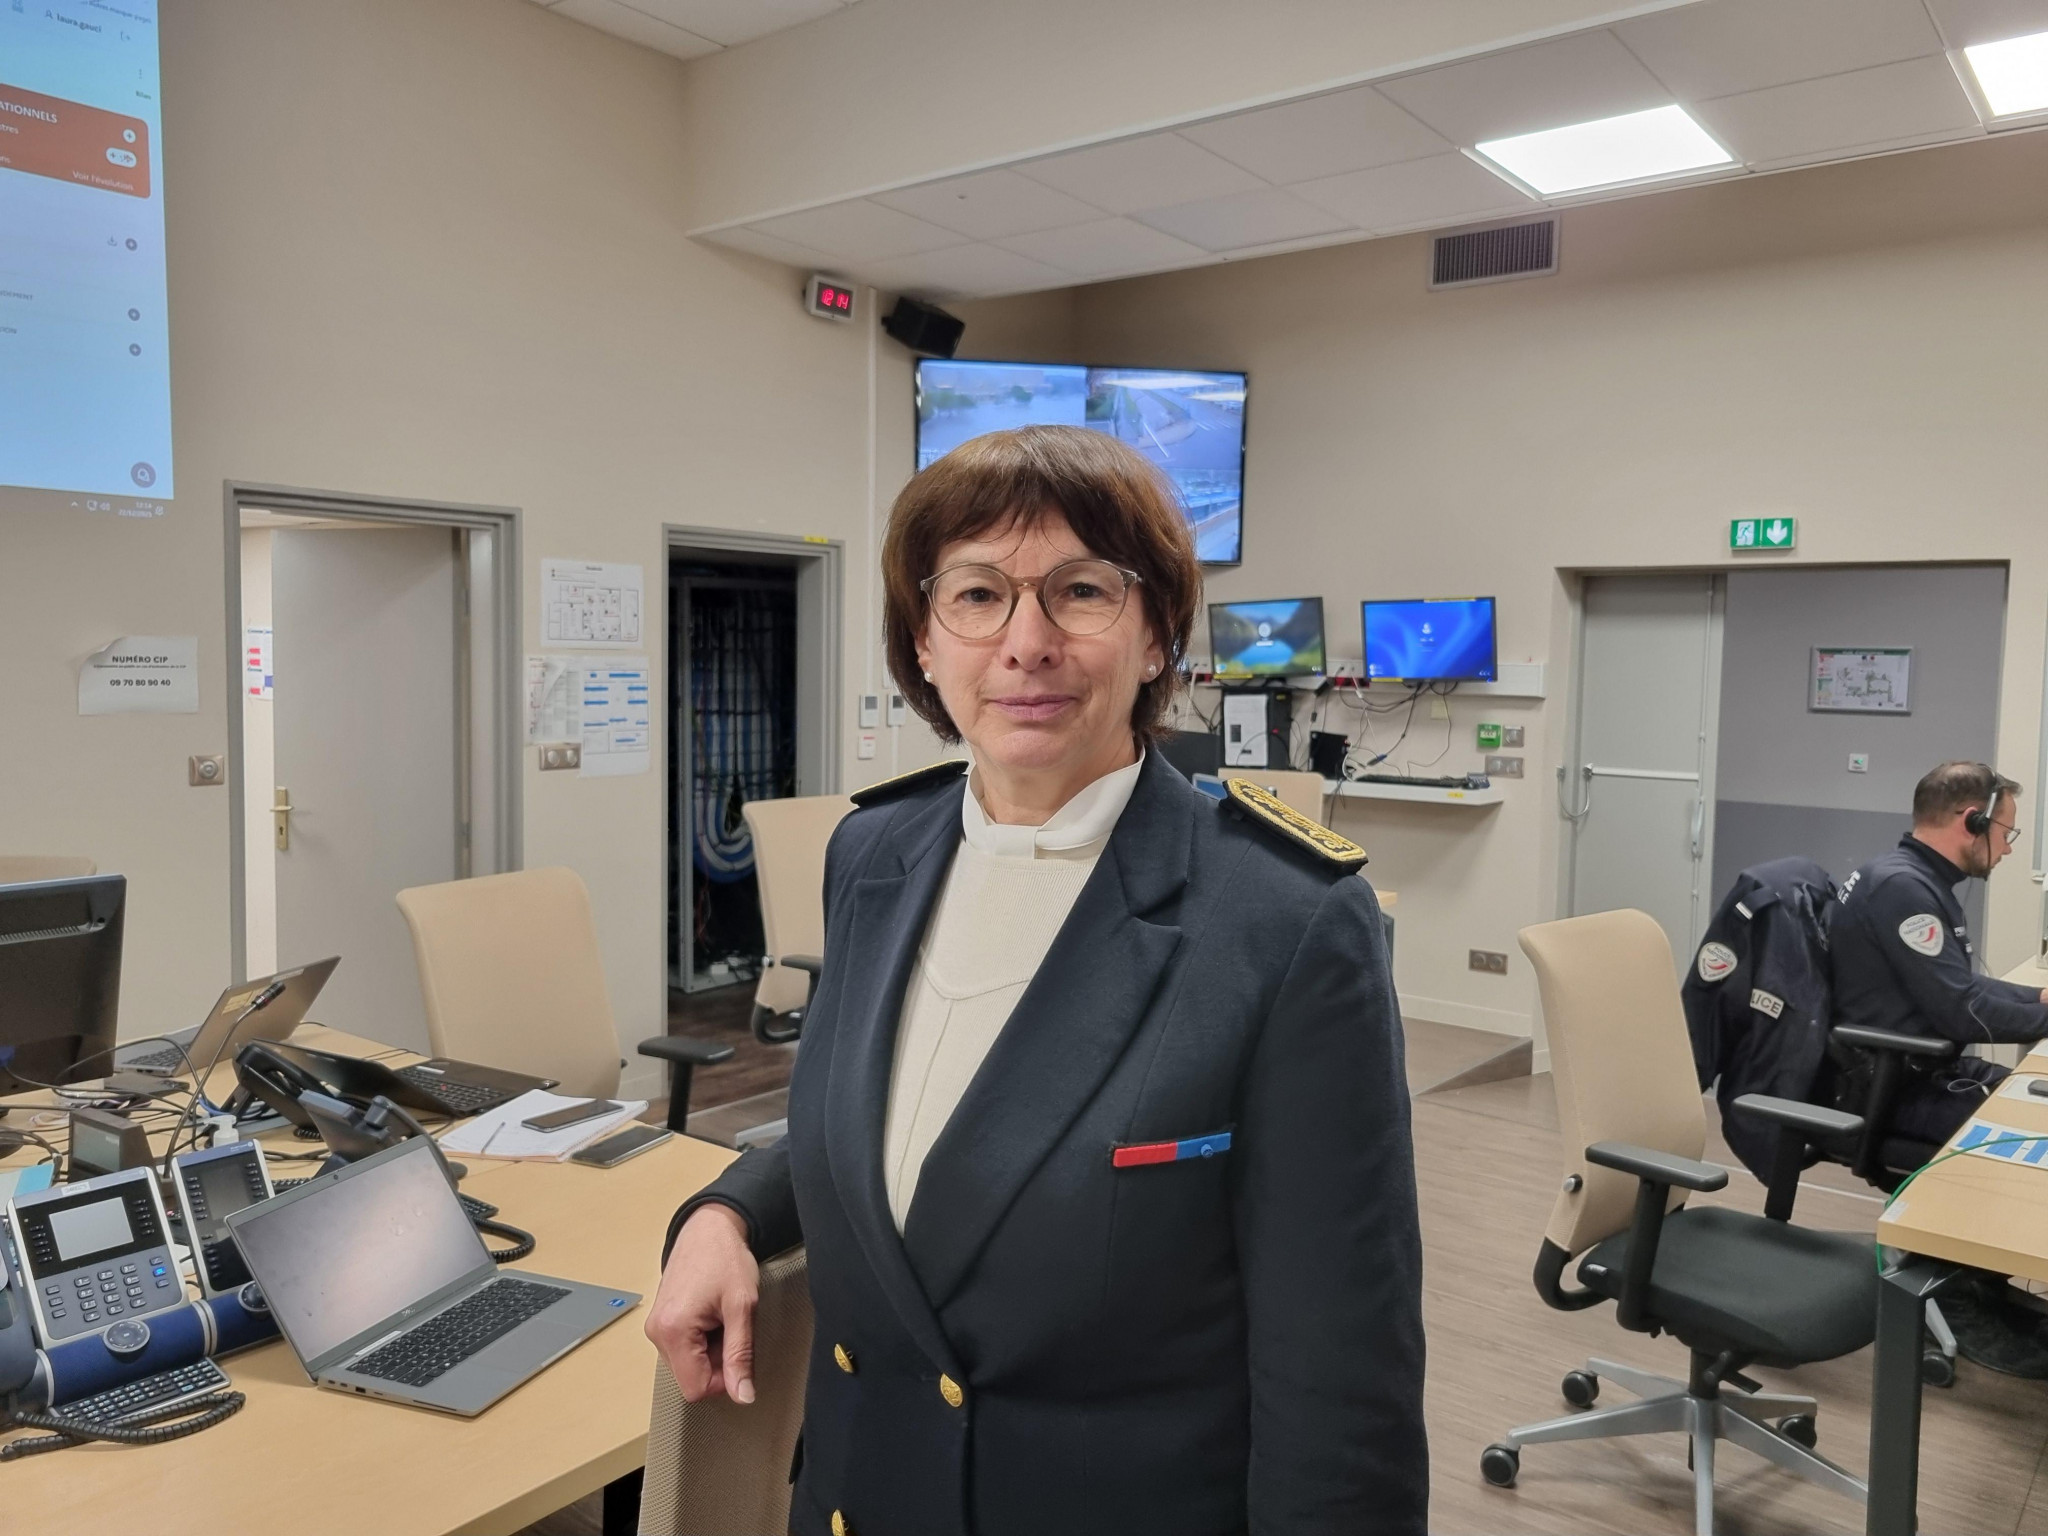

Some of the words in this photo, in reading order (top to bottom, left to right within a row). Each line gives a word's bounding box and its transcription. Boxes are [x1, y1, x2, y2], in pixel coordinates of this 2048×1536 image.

[112, 655, 151, 664] NUMÉRO
[153, 656, 168, 664] CIP
[110, 679, 121, 687] 09
[123, 679, 133, 687] 70
[160, 679, 171, 687] 40
